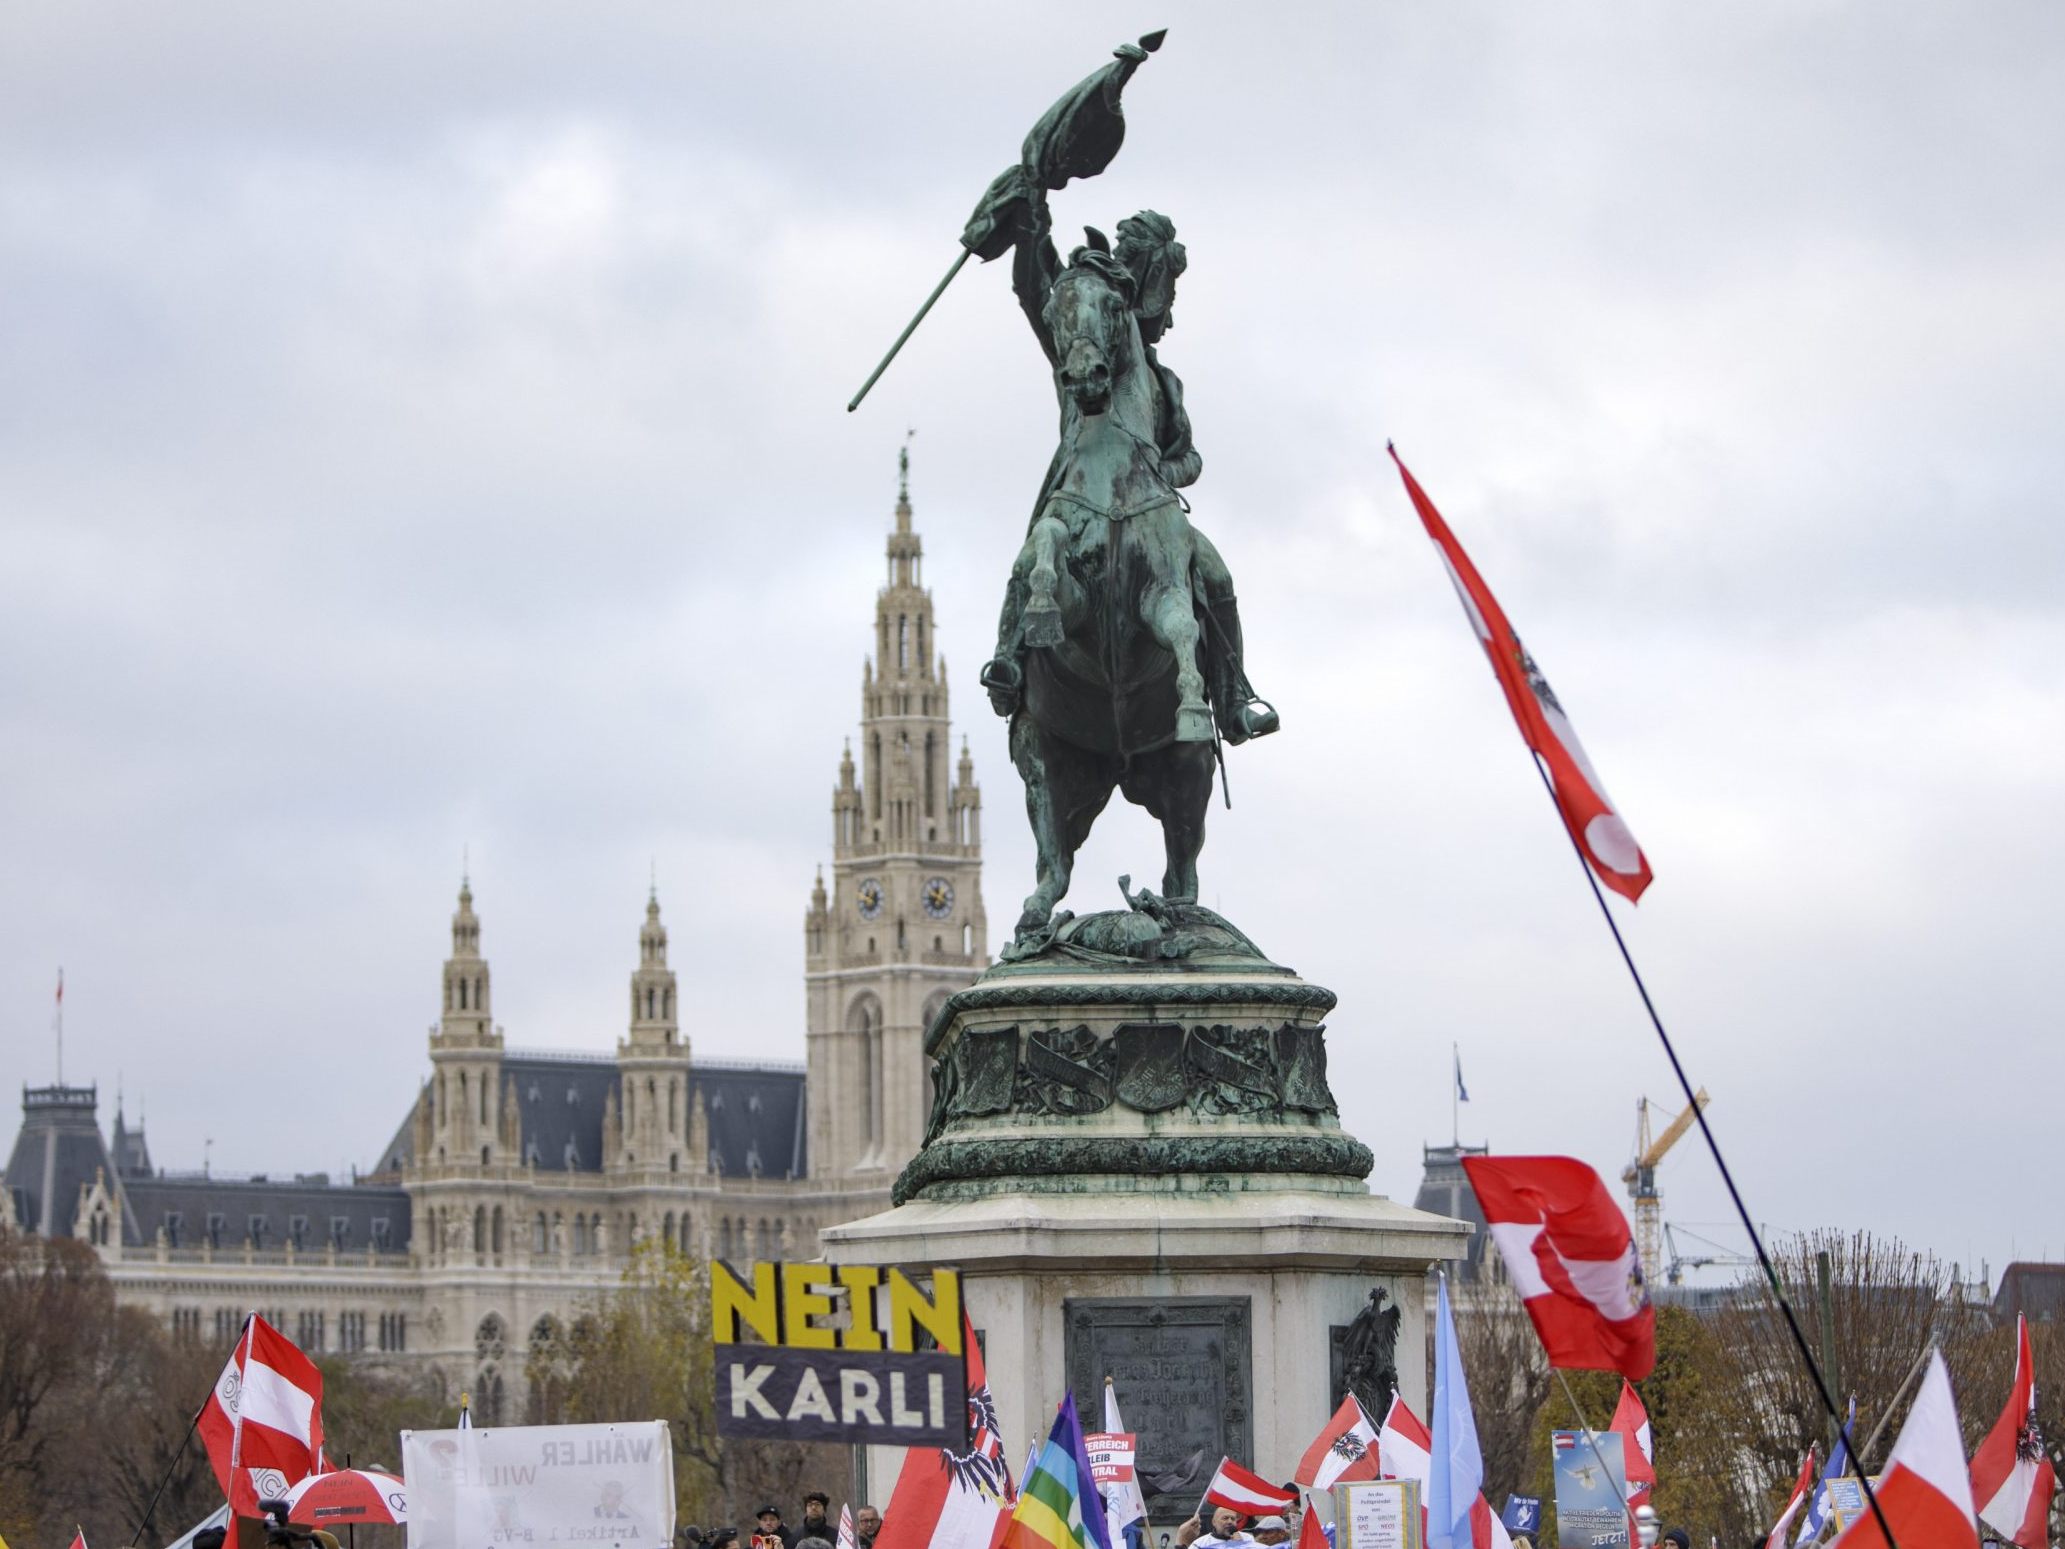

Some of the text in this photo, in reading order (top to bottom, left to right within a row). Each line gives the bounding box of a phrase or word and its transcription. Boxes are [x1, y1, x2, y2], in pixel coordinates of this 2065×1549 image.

[711, 1259, 962, 1356] NEIN
[730, 1363, 945, 1429] KARLI
[1088, 1454, 1111, 1464] LEIB
[1591, 1529, 1626, 1546] JETZT!
